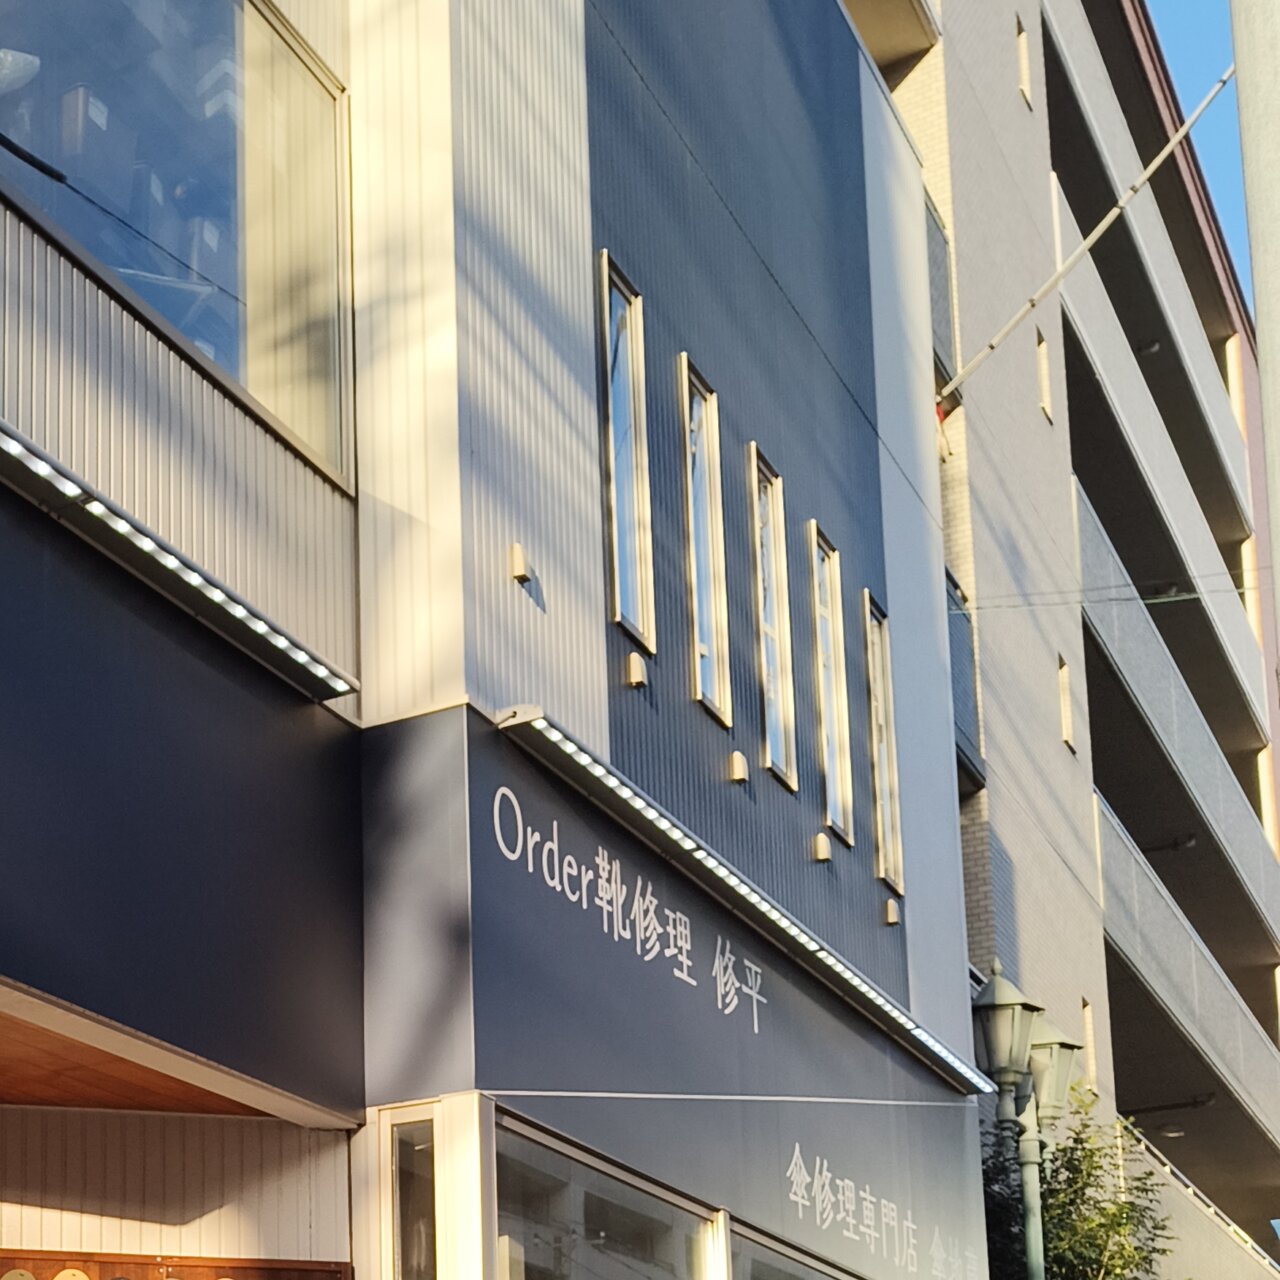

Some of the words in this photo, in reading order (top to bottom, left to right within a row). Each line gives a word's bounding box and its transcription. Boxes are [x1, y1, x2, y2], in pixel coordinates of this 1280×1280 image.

[493, 786, 698, 987] Order靴修理
[711, 934, 768, 1034] 修平
[786, 1142, 918, 1275] 傘修理専門店
